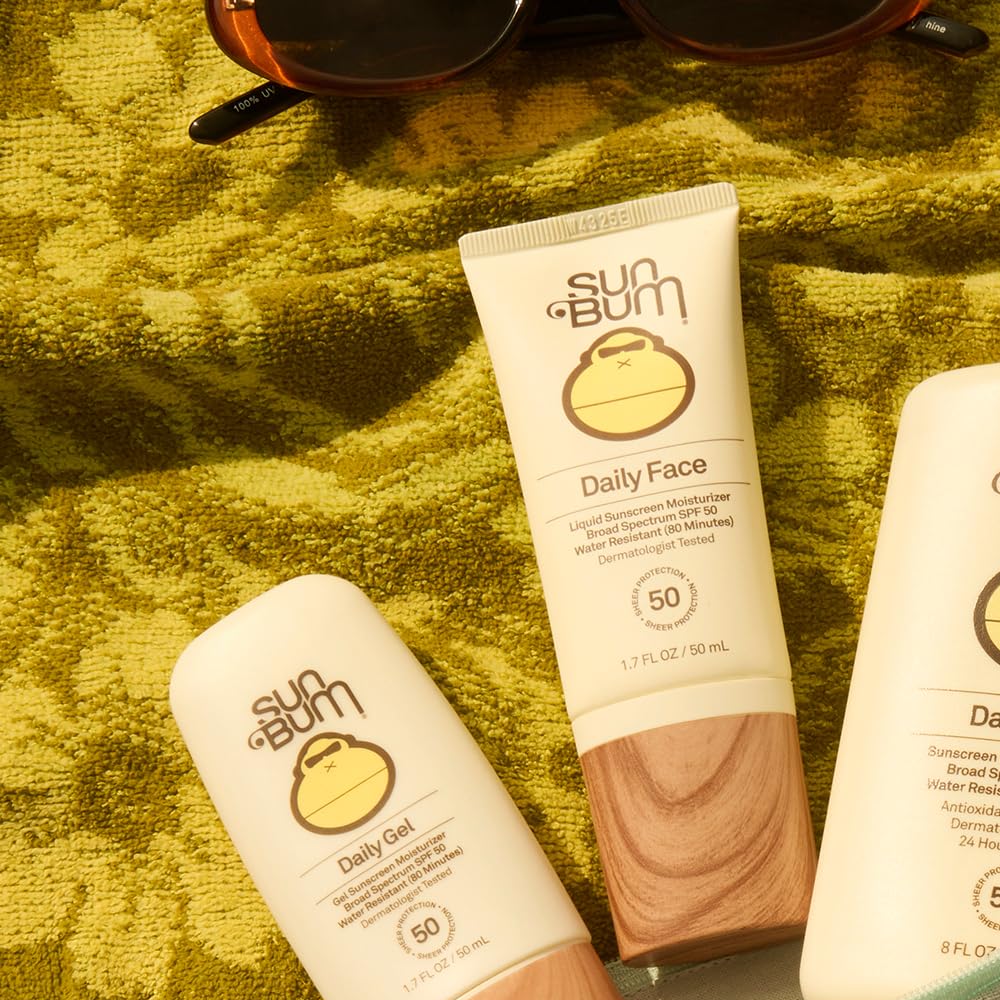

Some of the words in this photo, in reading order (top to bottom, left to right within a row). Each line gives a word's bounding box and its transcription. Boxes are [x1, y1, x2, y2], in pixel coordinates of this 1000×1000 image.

[233, 96, 259, 112] 100%
[581, 467, 642, 497] Daily
[647, 458, 707, 483] Face
[569, 514, 603, 532] Liquid
[604, 503, 664, 522] Sunscreen
[666, 493, 731, 509] Moisturizer
[586, 523, 619, 540] Broad
[621, 513, 677, 532] Spectrum
[678, 507, 701, 520] SPF
[703, 505, 718, 516] 50
[574, 541, 607, 556] Water
[608, 527, 663, 547] Resistant
[664, 523, 682, 536] (80
[684, 515, 734, 531] Minutes)
[598, 540, 677, 565] Dermatologist
[677, 533, 715, 547] Tested
[635, 566, 686, 588] PROTECTION
[631, 588, 643, 617] SHEER
[644, 620, 673, 631] SHEER
[674, 582, 698, 628] PROTECTION
[648, 586, 680, 611] 50
[621, 656, 639, 671] 1.7
[641, 652, 659, 666] FL
[660, 647, 679, 661] OZ
[681, 645, 687, 658] /
[689, 643, 706, 656] 50
[709, 640, 730, 653] mL
[928, 746, 998, 762] Sunscreen
[928, 778, 966, 792] Water
[947, 763, 987, 778] Broad
[337, 839, 382, 874] Daily
[382, 817, 416, 845] Gel
[959, 835, 975, 847] 24
[332, 892, 349, 906] Gel
[347, 863, 396, 896] Sunscreen
[394, 832, 446, 867] Moisturizer
[343, 890, 372, 912] Broad
[370, 864, 416, 894] Spectrum
[414, 849, 433, 867] SPF
[433, 843, 446, 855] 50
[337, 908, 364, 928] Water
[364, 880, 408, 911] Resistant
[407, 870, 423, 885] (80
[422, 845, 464, 874] Minutes)
[360, 886, 423, 929] Dermatologist
[421, 866, 453, 889] Tested
[972, 878, 986, 907] SHEER
[396, 901, 437, 929] PROTECTION
[410, 917, 440, 944] 50
[396, 930, 412, 954] SHEER
[417, 948, 443, 960] SHEER
[441, 907, 456, 951] PROTECTION
[941, 940, 950, 954] 8
[953, 942, 971, 957] FL
[403, 977, 418, 993] 1.7
[418, 970, 435, 983] FL
[433, 957, 450, 973] OZ
[451, 953, 455, 964] /
[455, 945, 471, 959] 50
[471, 936, 490, 950] mL
